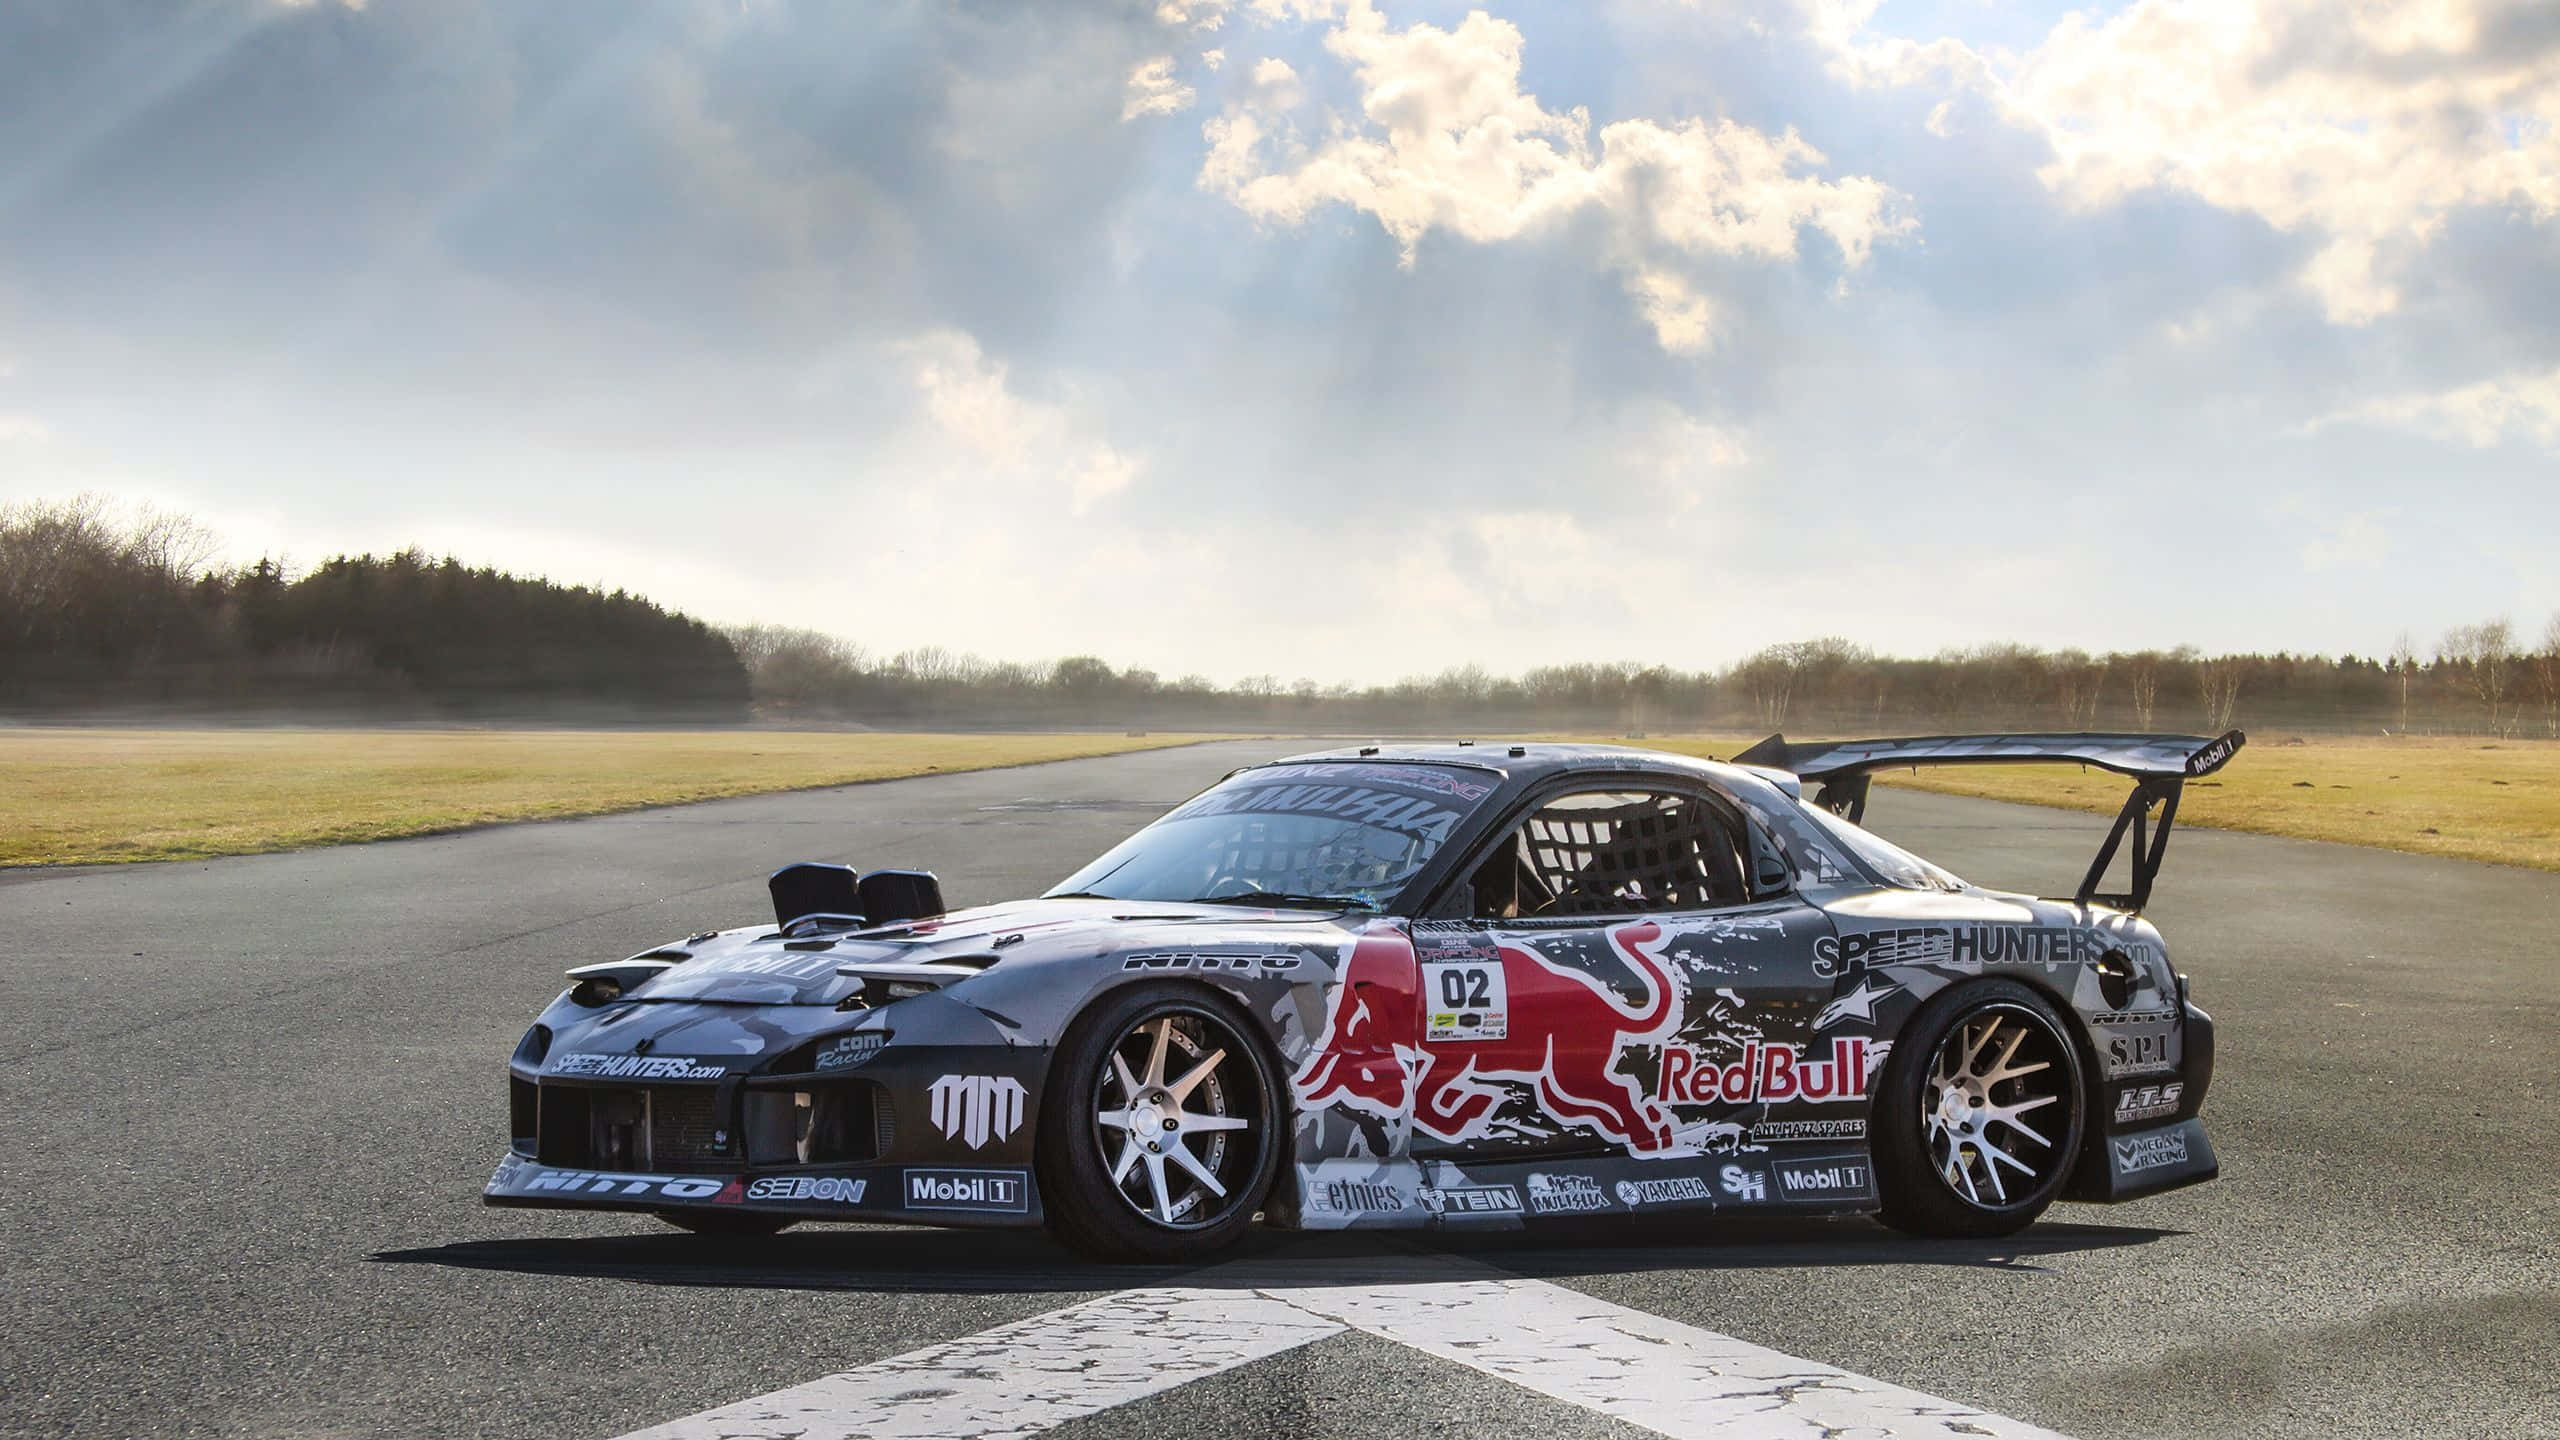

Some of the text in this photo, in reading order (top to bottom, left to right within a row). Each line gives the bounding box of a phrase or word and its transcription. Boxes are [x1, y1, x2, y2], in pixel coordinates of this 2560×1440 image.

[2193, 743, 2226, 774] Mobil
[1122, 952, 1301, 970] NITTO
[1419, 945, 1501, 960] DRIFTING
[1811, 925, 2153, 978] SPEEDHUNTERSom
[1440, 969, 1491, 1008] 02
[2090, 1007, 2179, 1025] NITTO
[834, 1034, 883, 1052] .com
[551, 1054, 726, 1079] SPEEDHUNTERS.com
[815, 1050, 880, 1070] Racin
[1658, 1040, 1865, 1101] Red Bull
[1816, 1119, 1865, 1134] SPARES
[2137, 1130, 2185, 1152] MEGAN
[2139, 1148, 2187, 1167] RACING
[524, 1171, 723, 1198] NITTO
[748, 1177, 867, 1203] SEBON
[912, 1178, 984, 1201] Mobil
[1546, 1174, 1602, 1194] METAL
[1638, 1177, 1712, 1202] YAMAHA
[1784, 1168, 1841, 1191] Mobil
[1327, 1178, 1403, 1216] etnies
[1447, 1189, 1517, 1212] TEIN
